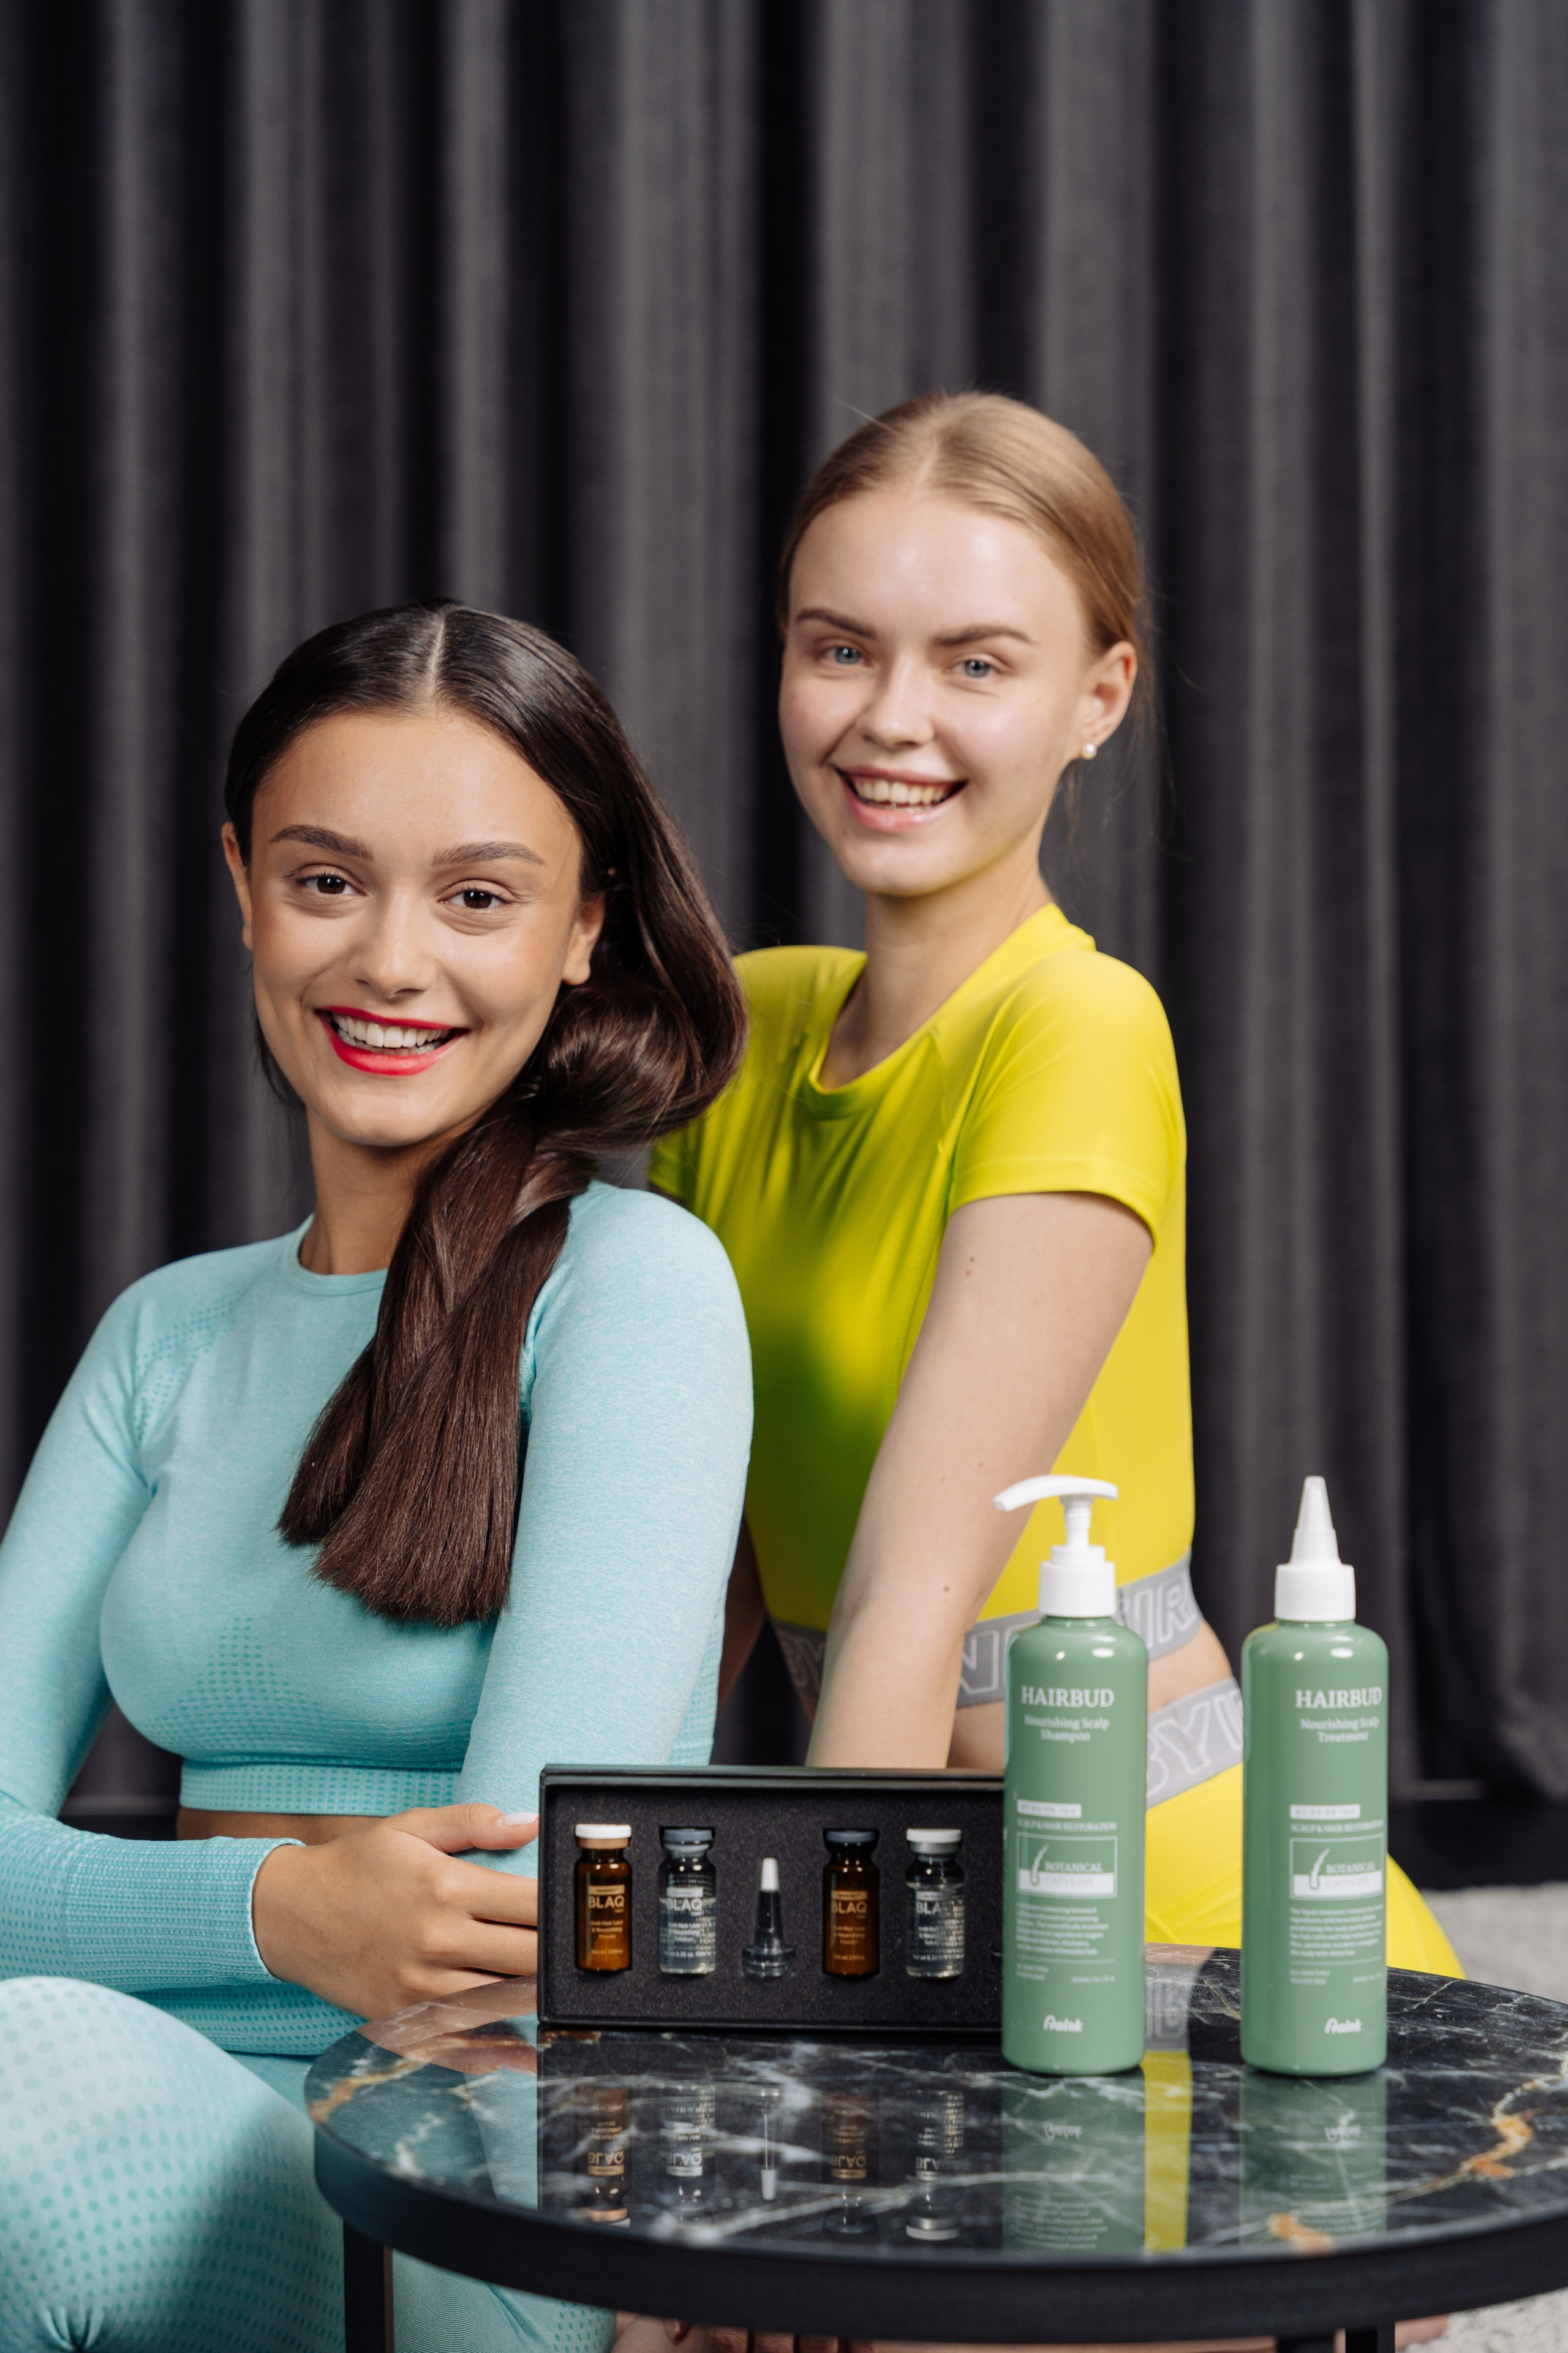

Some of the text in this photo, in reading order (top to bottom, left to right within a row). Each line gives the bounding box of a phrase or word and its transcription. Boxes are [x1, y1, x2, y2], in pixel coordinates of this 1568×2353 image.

[1021, 1685, 1115, 1708] HAIRBUD
[1295, 1686, 1382, 1709] HAIRBUD
[1024, 1714, 1110, 1731] Nourishing Scalp
[1300, 1715, 1379, 1731] Nourishing Scalp
[1040, 1730, 1091, 1744] Shampoo
[1317, 1731, 1369, 1743] Treatment
[1044, 1860, 1102, 1873] BOTANICAL
[1046, 1876, 1095, 1886] CAFFEINE
[588, 1895, 625, 1909] BLAQ
[666, 1898, 703, 1912] BLAQ
[831, 1900, 867, 1914] BLAQ
[916, 1901, 942, 1915] BLA
